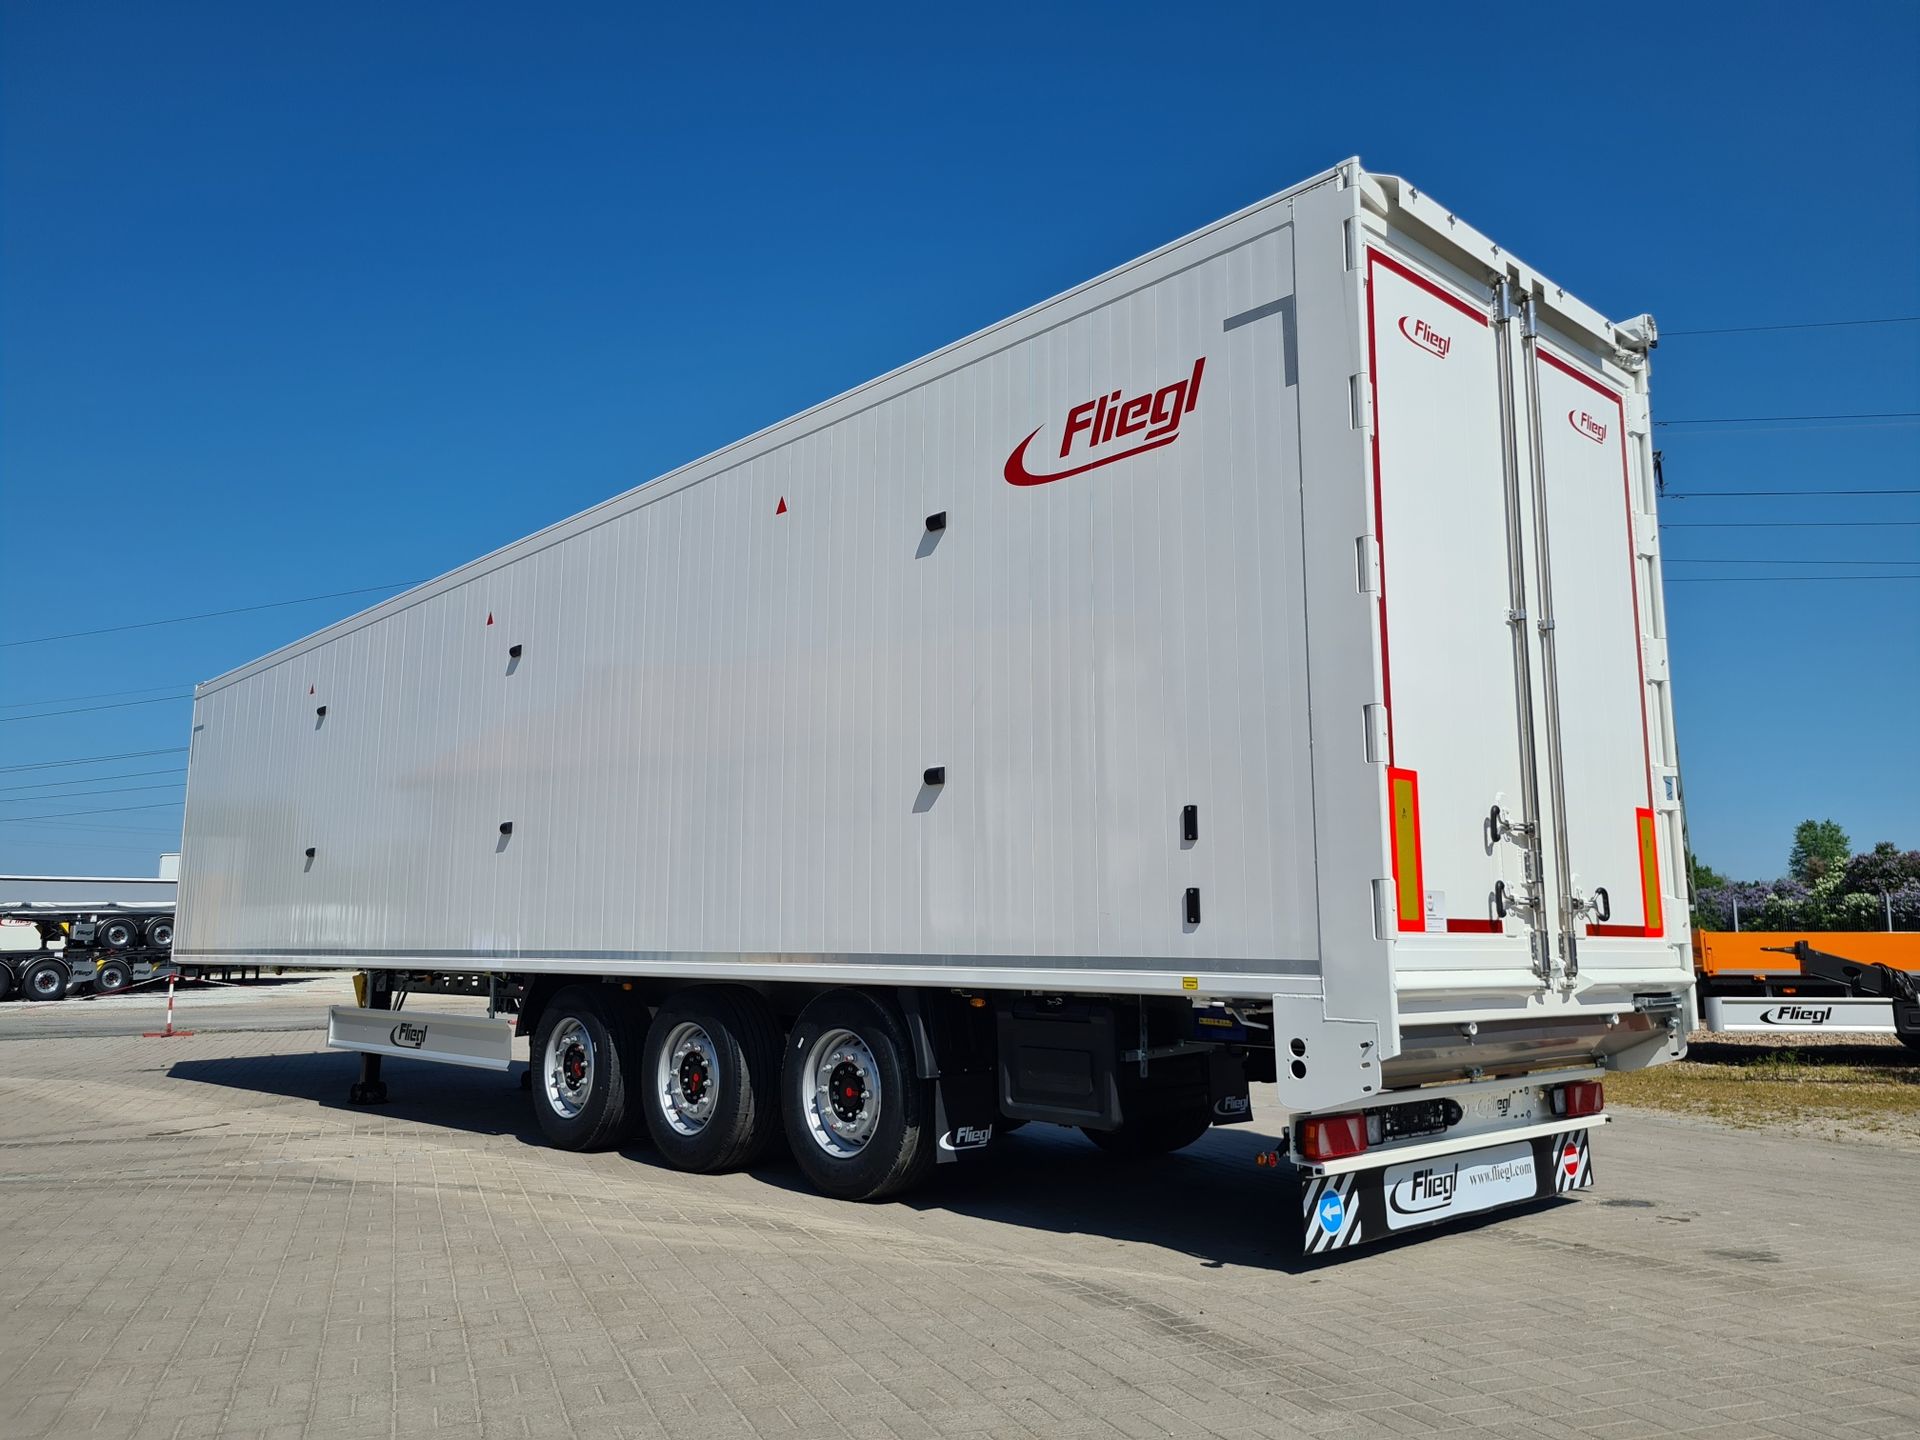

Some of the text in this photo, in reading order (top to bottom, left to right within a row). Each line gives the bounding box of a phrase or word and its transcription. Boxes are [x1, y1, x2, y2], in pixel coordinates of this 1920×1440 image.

[1414, 319, 1451, 356] Fliegl
[1059, 356, 1206, 458] Fliegl
[1580, 412, 1607, 441] Fliegl
[1777, 1006, 1832, 1024] Fliegl
[399, 1022, 428, 1046] Fliegl
[1225, 1094, 1249, 1111] Fliegl
[956, 1124, 993, 1146] Fliegl
[1411, 1162, 1532, 1201] Fliegl www.fliegl.com
